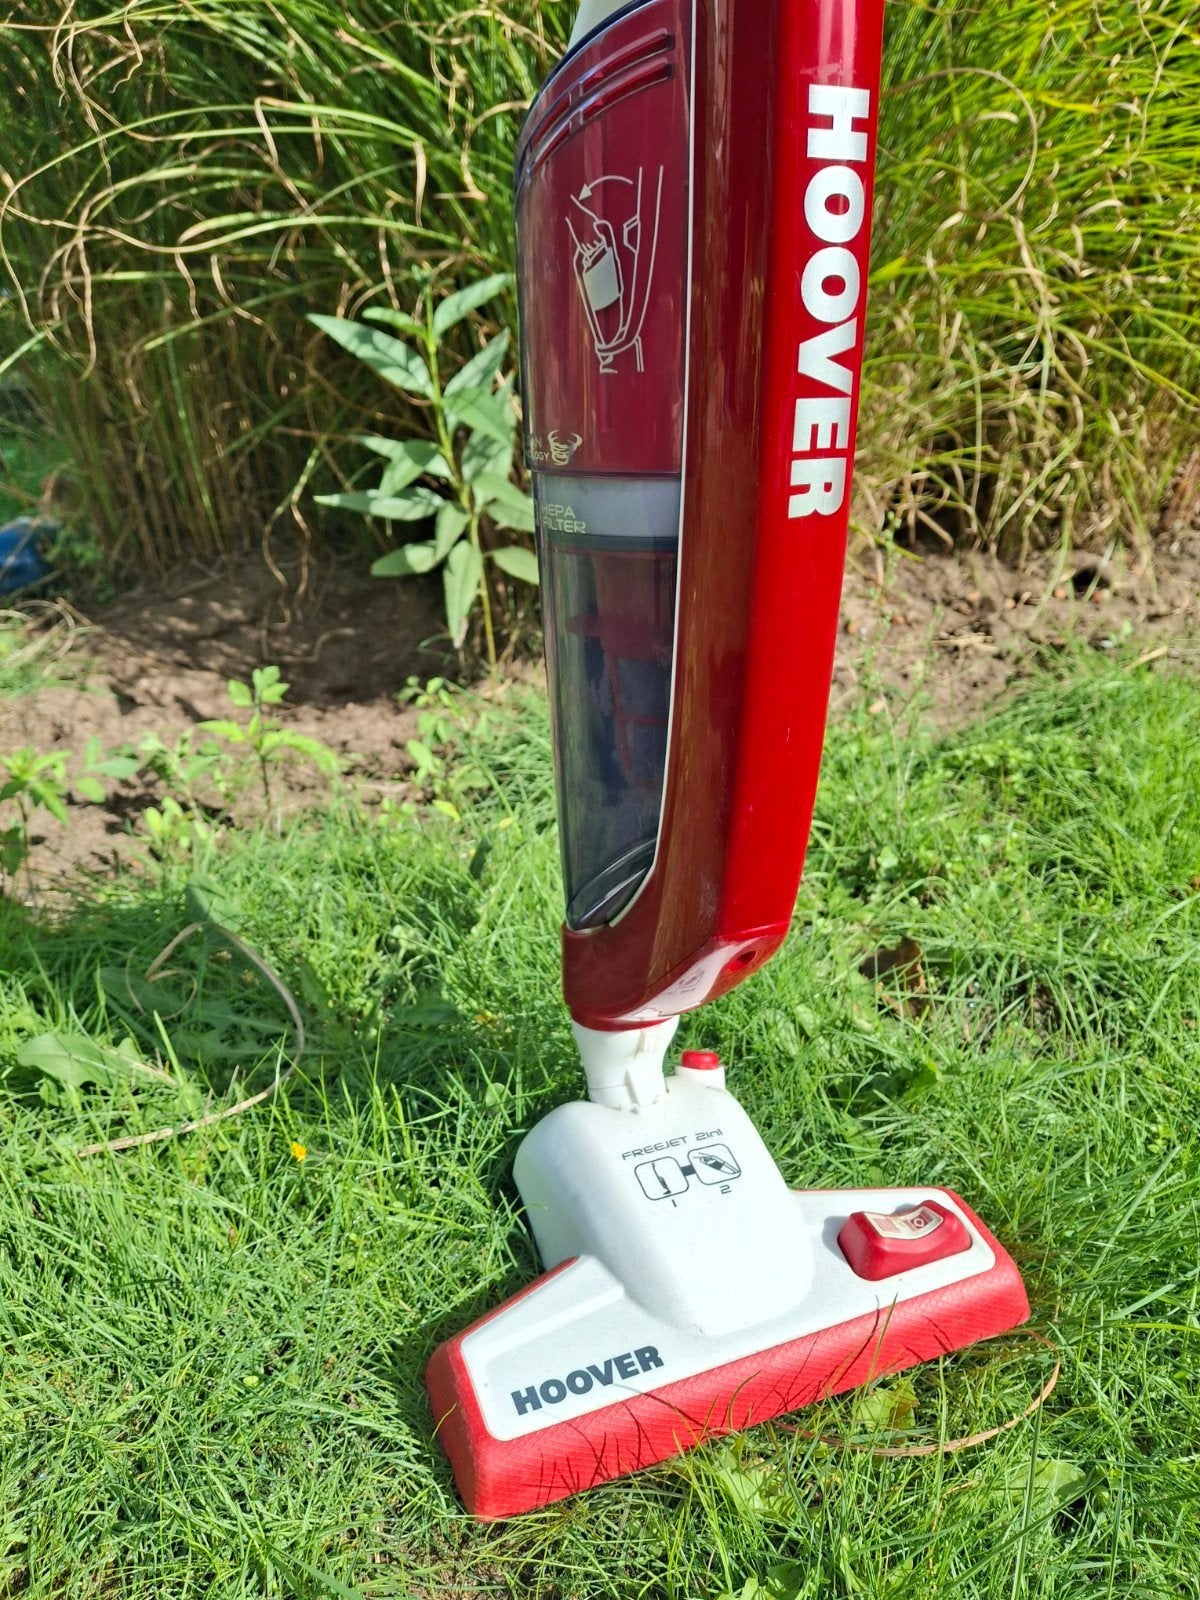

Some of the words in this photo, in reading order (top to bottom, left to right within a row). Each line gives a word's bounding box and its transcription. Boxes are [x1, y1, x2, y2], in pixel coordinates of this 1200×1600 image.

[788, 84, 870, 519] HOOVER
[542, 516, 586, 534] FILTER
[621, 1135, 687, 1161] FREEJET
[695, 1128, 724, 1141] 2in1
[719, 1184, 732, 1195] 2
[510, 1345, 665, 1416] HOOVER
